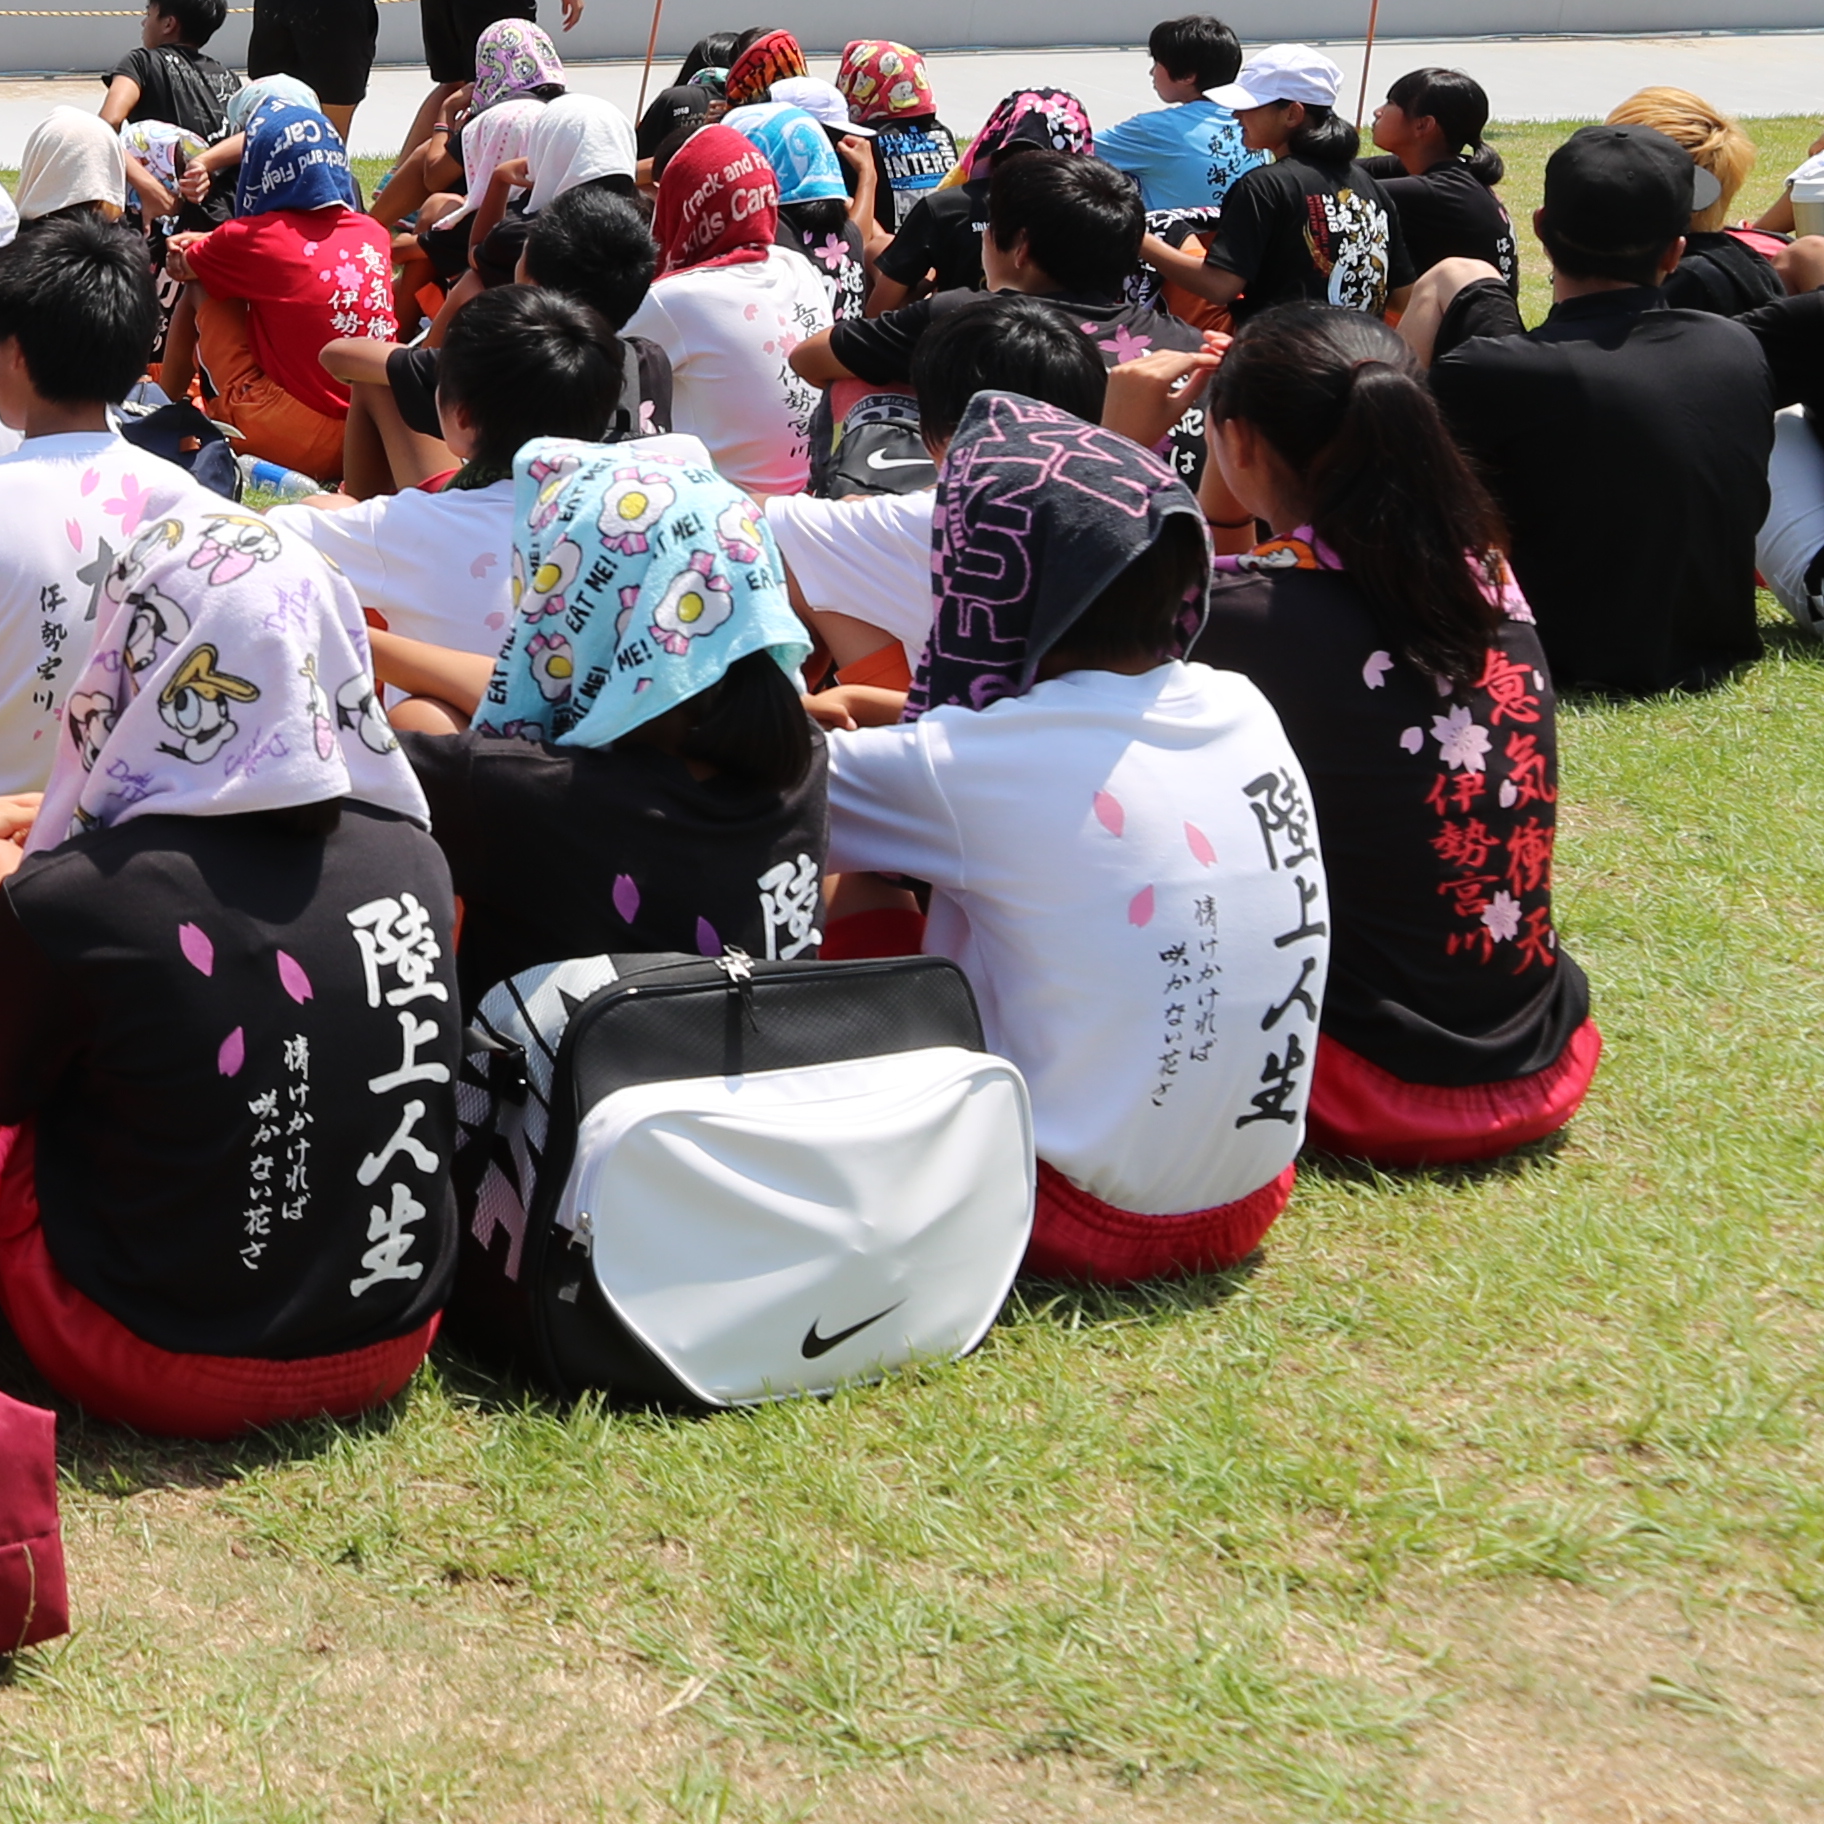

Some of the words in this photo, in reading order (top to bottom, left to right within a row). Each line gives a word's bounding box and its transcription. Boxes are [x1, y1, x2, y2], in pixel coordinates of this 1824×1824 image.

[722, 155, 752, 182] and
[885, 152, 946, 179] INTER
[1321, 193, 1340, 235] 2018
[327, 288, 364, 339] 伊勢
[557, 485, 586, 523] EAT
[671, 511, 705, 544] ME!
[564, 596, 595, 636] EAT
[590, 553, 619, 597] ME!
[32, 583, 68, 714] 伊勢宮川
[615, 638, 653, 673] ME!
[487, 663, 509, 706] EAT
[1473, 647, 1558, 977] 意気衝天
[1424, 772, 1501, 965] 伊勢宮川
[756, 851, 826, 960] 陸
[1235, 764, 1332, 1132] 陸上人生
[346, 889, 457, 1303] 陸上人生
